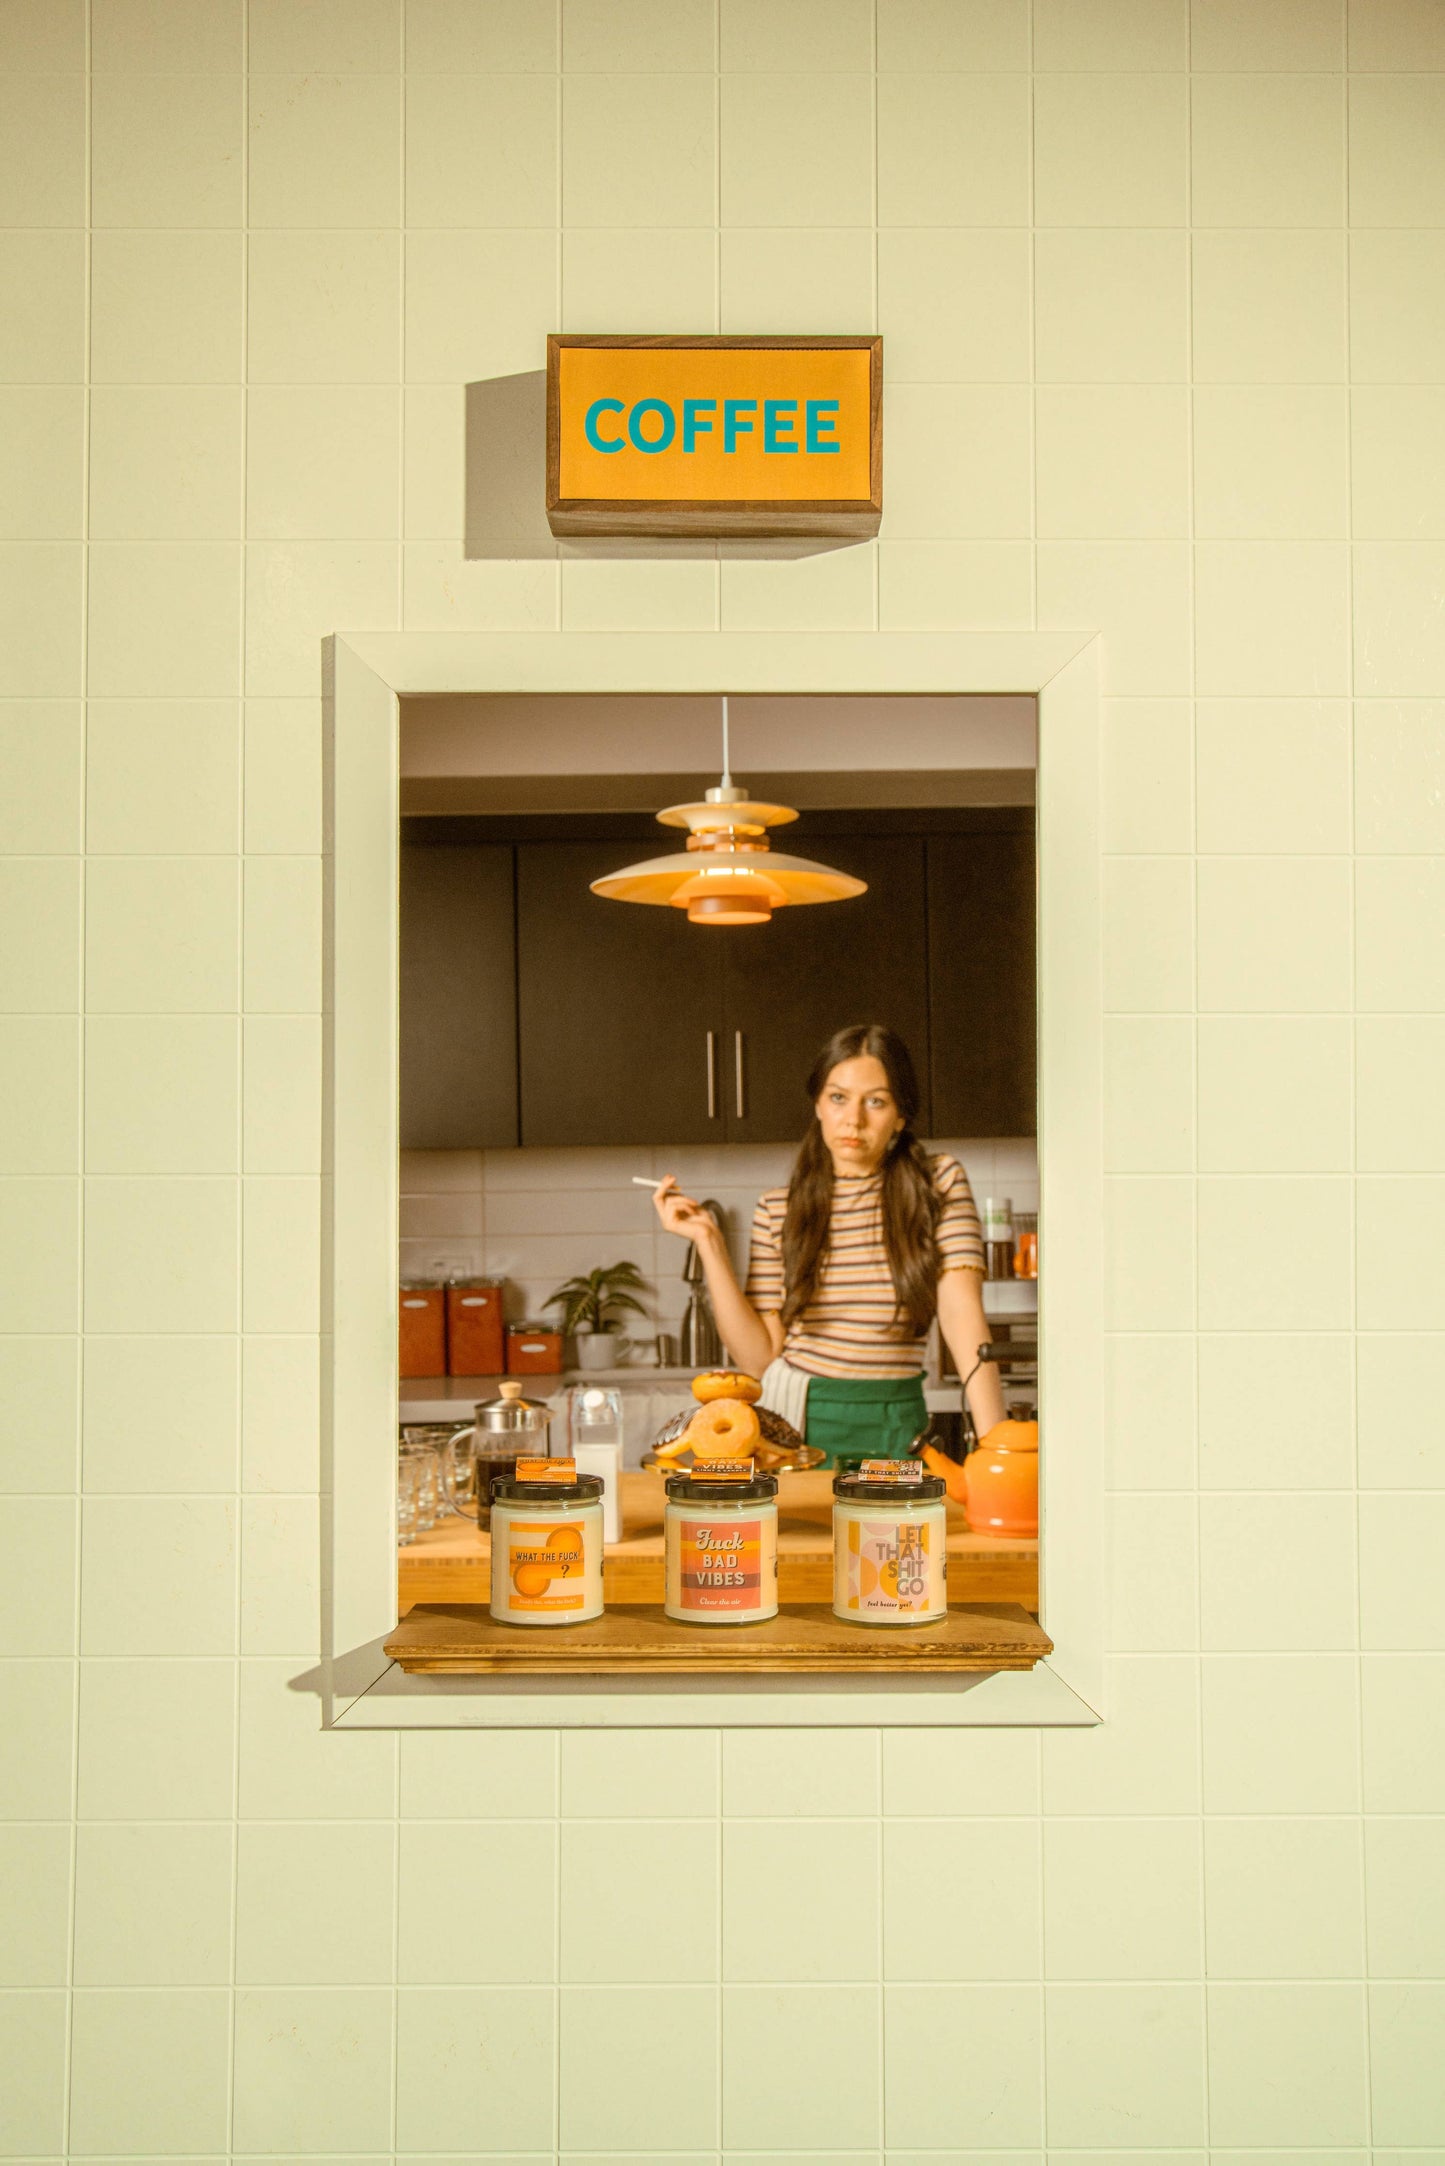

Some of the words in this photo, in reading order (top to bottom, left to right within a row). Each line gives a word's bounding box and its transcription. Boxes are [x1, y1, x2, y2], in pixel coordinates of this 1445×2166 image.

[584, 398, 840, 454] COFFEE
[696, 1529, 745, 1551] Fuck
[896, 1526, 924, 1544] LET
[516, 1552, 538, 1561] WHAT
[541, 1552, 556, 1561] THE
[559, 1551, 578, 1561] FUCK
[876, 1543, 924, 1561] THAT
[703, 1554, 738, 1569] BAD
[888, 1560, 924, 1578] SHIT
[561, 1564, 570, 1579] ?
[696, 1571, 745, 1587] VIBES
[896, 1578, 925, 1596] GO
[699, 1597, 718, 1605] Clear
[899, 1601, 913, 1609] yet?
